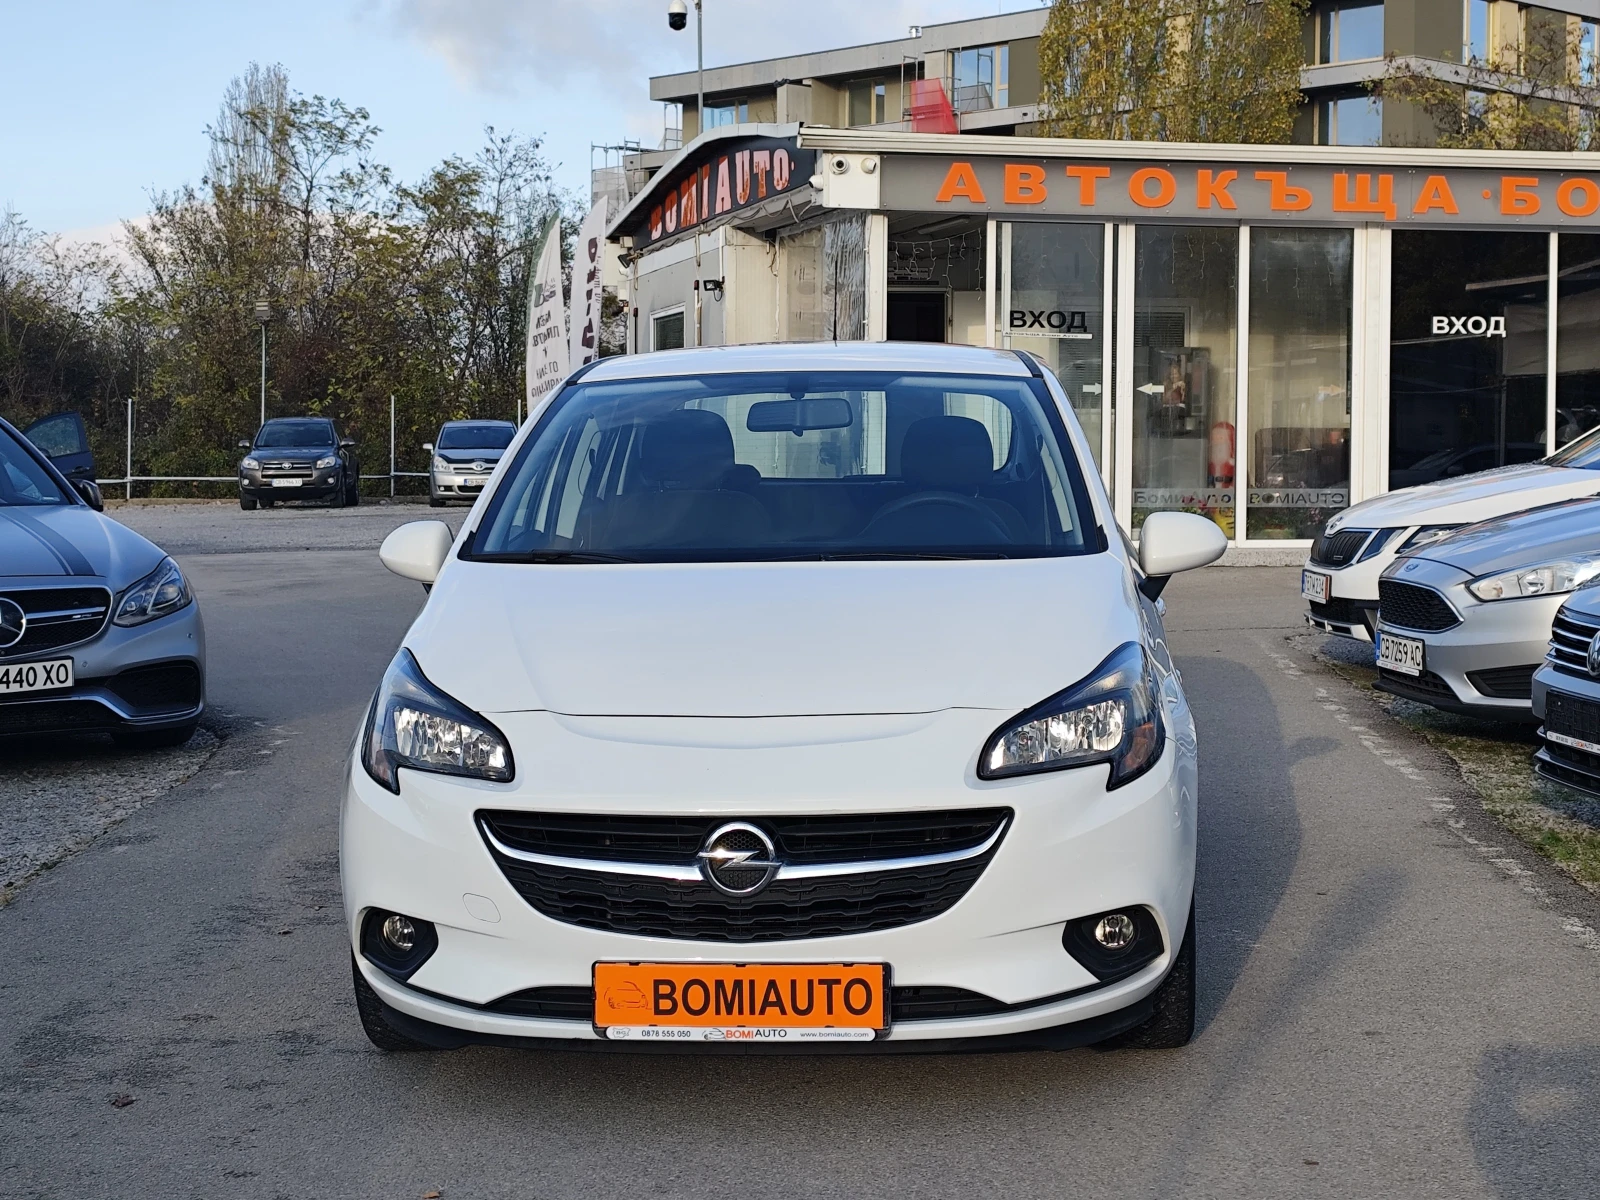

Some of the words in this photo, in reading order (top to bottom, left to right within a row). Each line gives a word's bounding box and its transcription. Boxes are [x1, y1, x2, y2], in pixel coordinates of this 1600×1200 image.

[936, 162, 1459, 221] АВТОКЪЩА
[1009, 310, 1088, 333] ВХОД
[1431, 315, 1507, 338] ВХОД
[1249, 493, 1345, 504] BOMIAUTO
[1411, 645, 1420, 667] AC
[42, 663, 69, 687] XO
[653, 978, 873, 1017] BOMIAUTO
[641, 1029, 660, 1038] 0878
[661, 1030, 676, 1038] 555
[677, 1030, 691, 1038] 050
